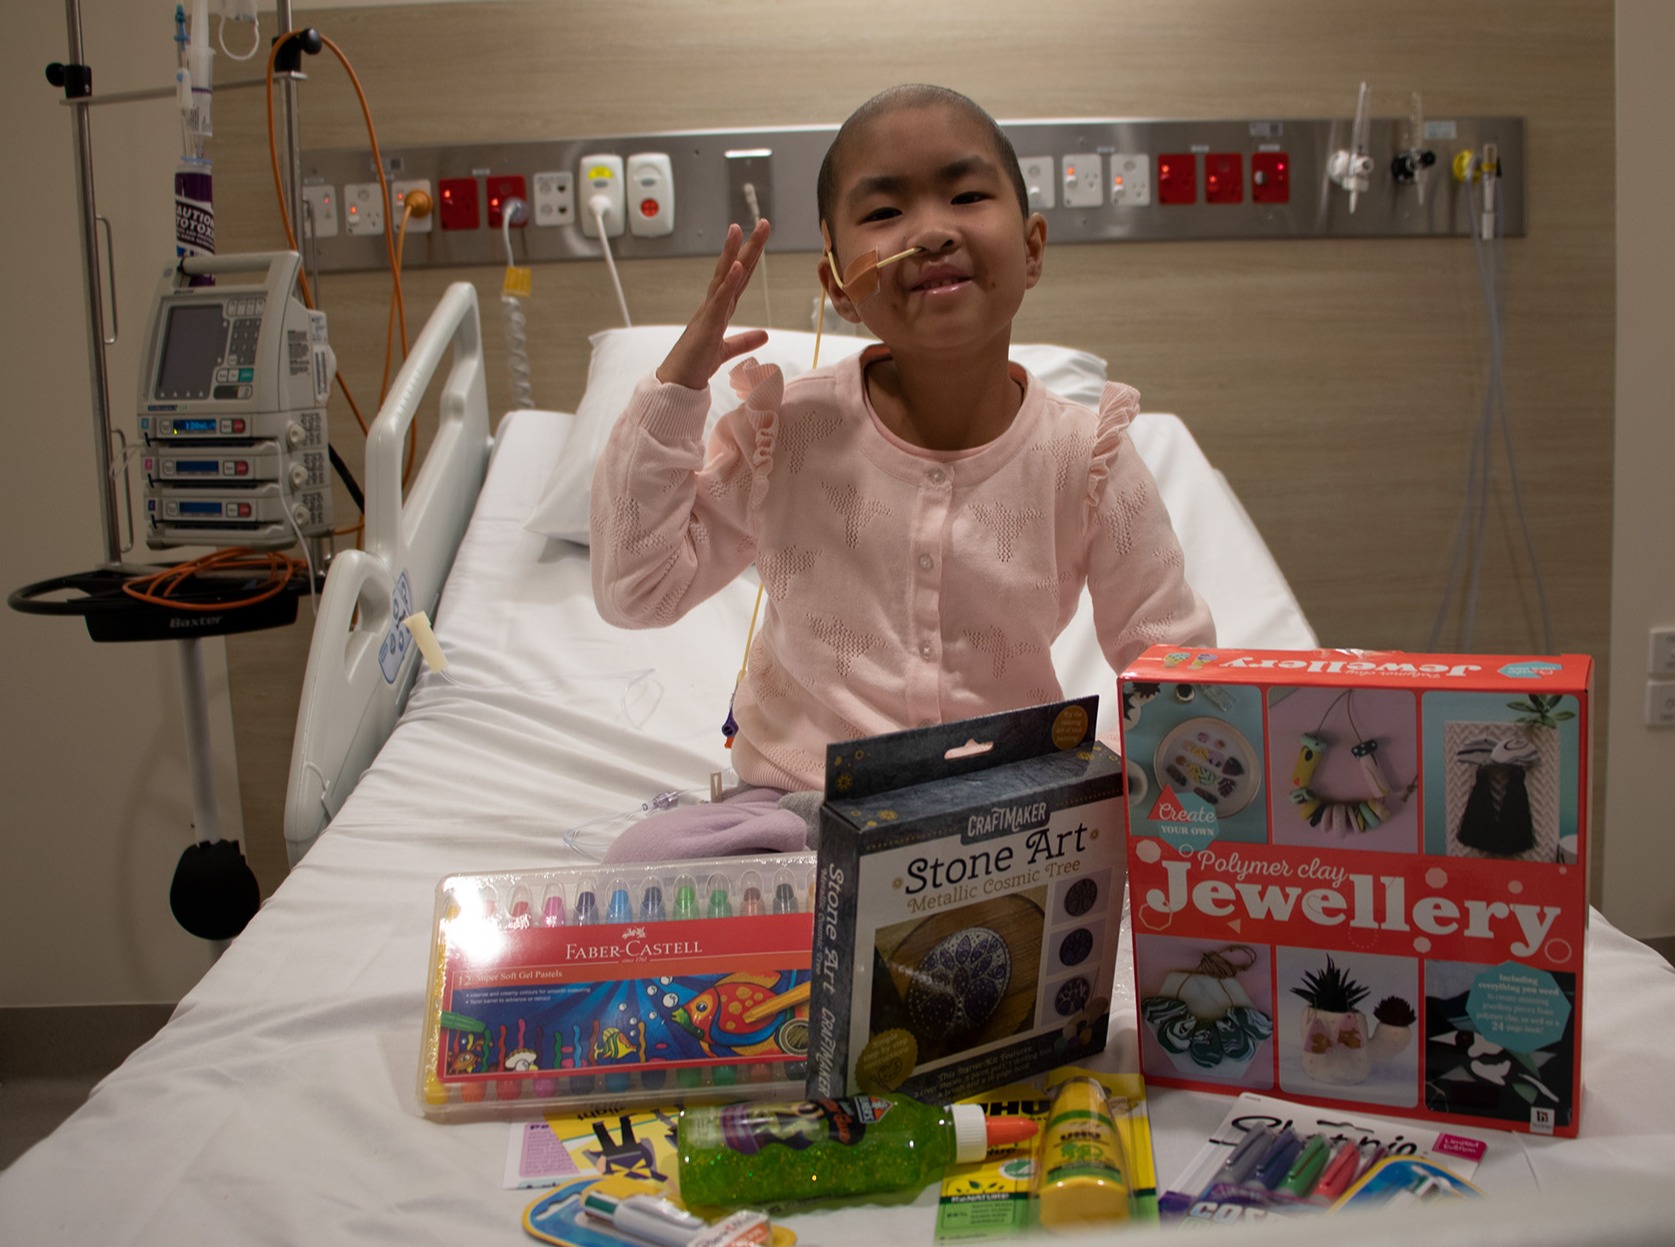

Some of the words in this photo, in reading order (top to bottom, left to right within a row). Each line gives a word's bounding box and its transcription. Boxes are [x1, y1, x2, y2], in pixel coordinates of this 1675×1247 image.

[170, 616, 223, 628] Baxter
[1219, 657, 1481, 678] Jewellery
[967, 802, 1047, 837] CRAFTMAKER
[1159, 802, 1217, 823] Create
[1161, 825, 1189, 835] YOUR
[1191, 827, 1214, 836] OWN
[905, 846, 1014, 895] Stone
[1025, 822, 1088, 866] Art
[1198, 850, 1293, 881] Polymer
[1297, 858, 1348, 888] clay
[907, 885, 977, 914] Metallic
[983, 868, 1041, 895] Cosmic
[1045, 858, 1081, 879] Tree
[826, 862, 844, 940] Stone
[1146, 860, 1562, 957] Jewellery
[565, 940, 703, 960] FABER-CASTELL
[500, 972, 517, 981] Soft
[518, 971, 533, 979] Gel
[535, 970, 563, 978] Pastels
[823, 947, 839, 995] Art
[1499, 973, 1538, 986] Including
[1478, 982, 1521, 994] everything
[1522, 986, 1537, 994] you
[1538, 987, 1559, 996] need
[815, 1006, 836, 1098] CRAFTMAKER
[980, 1101, 1052, 1116] HU
